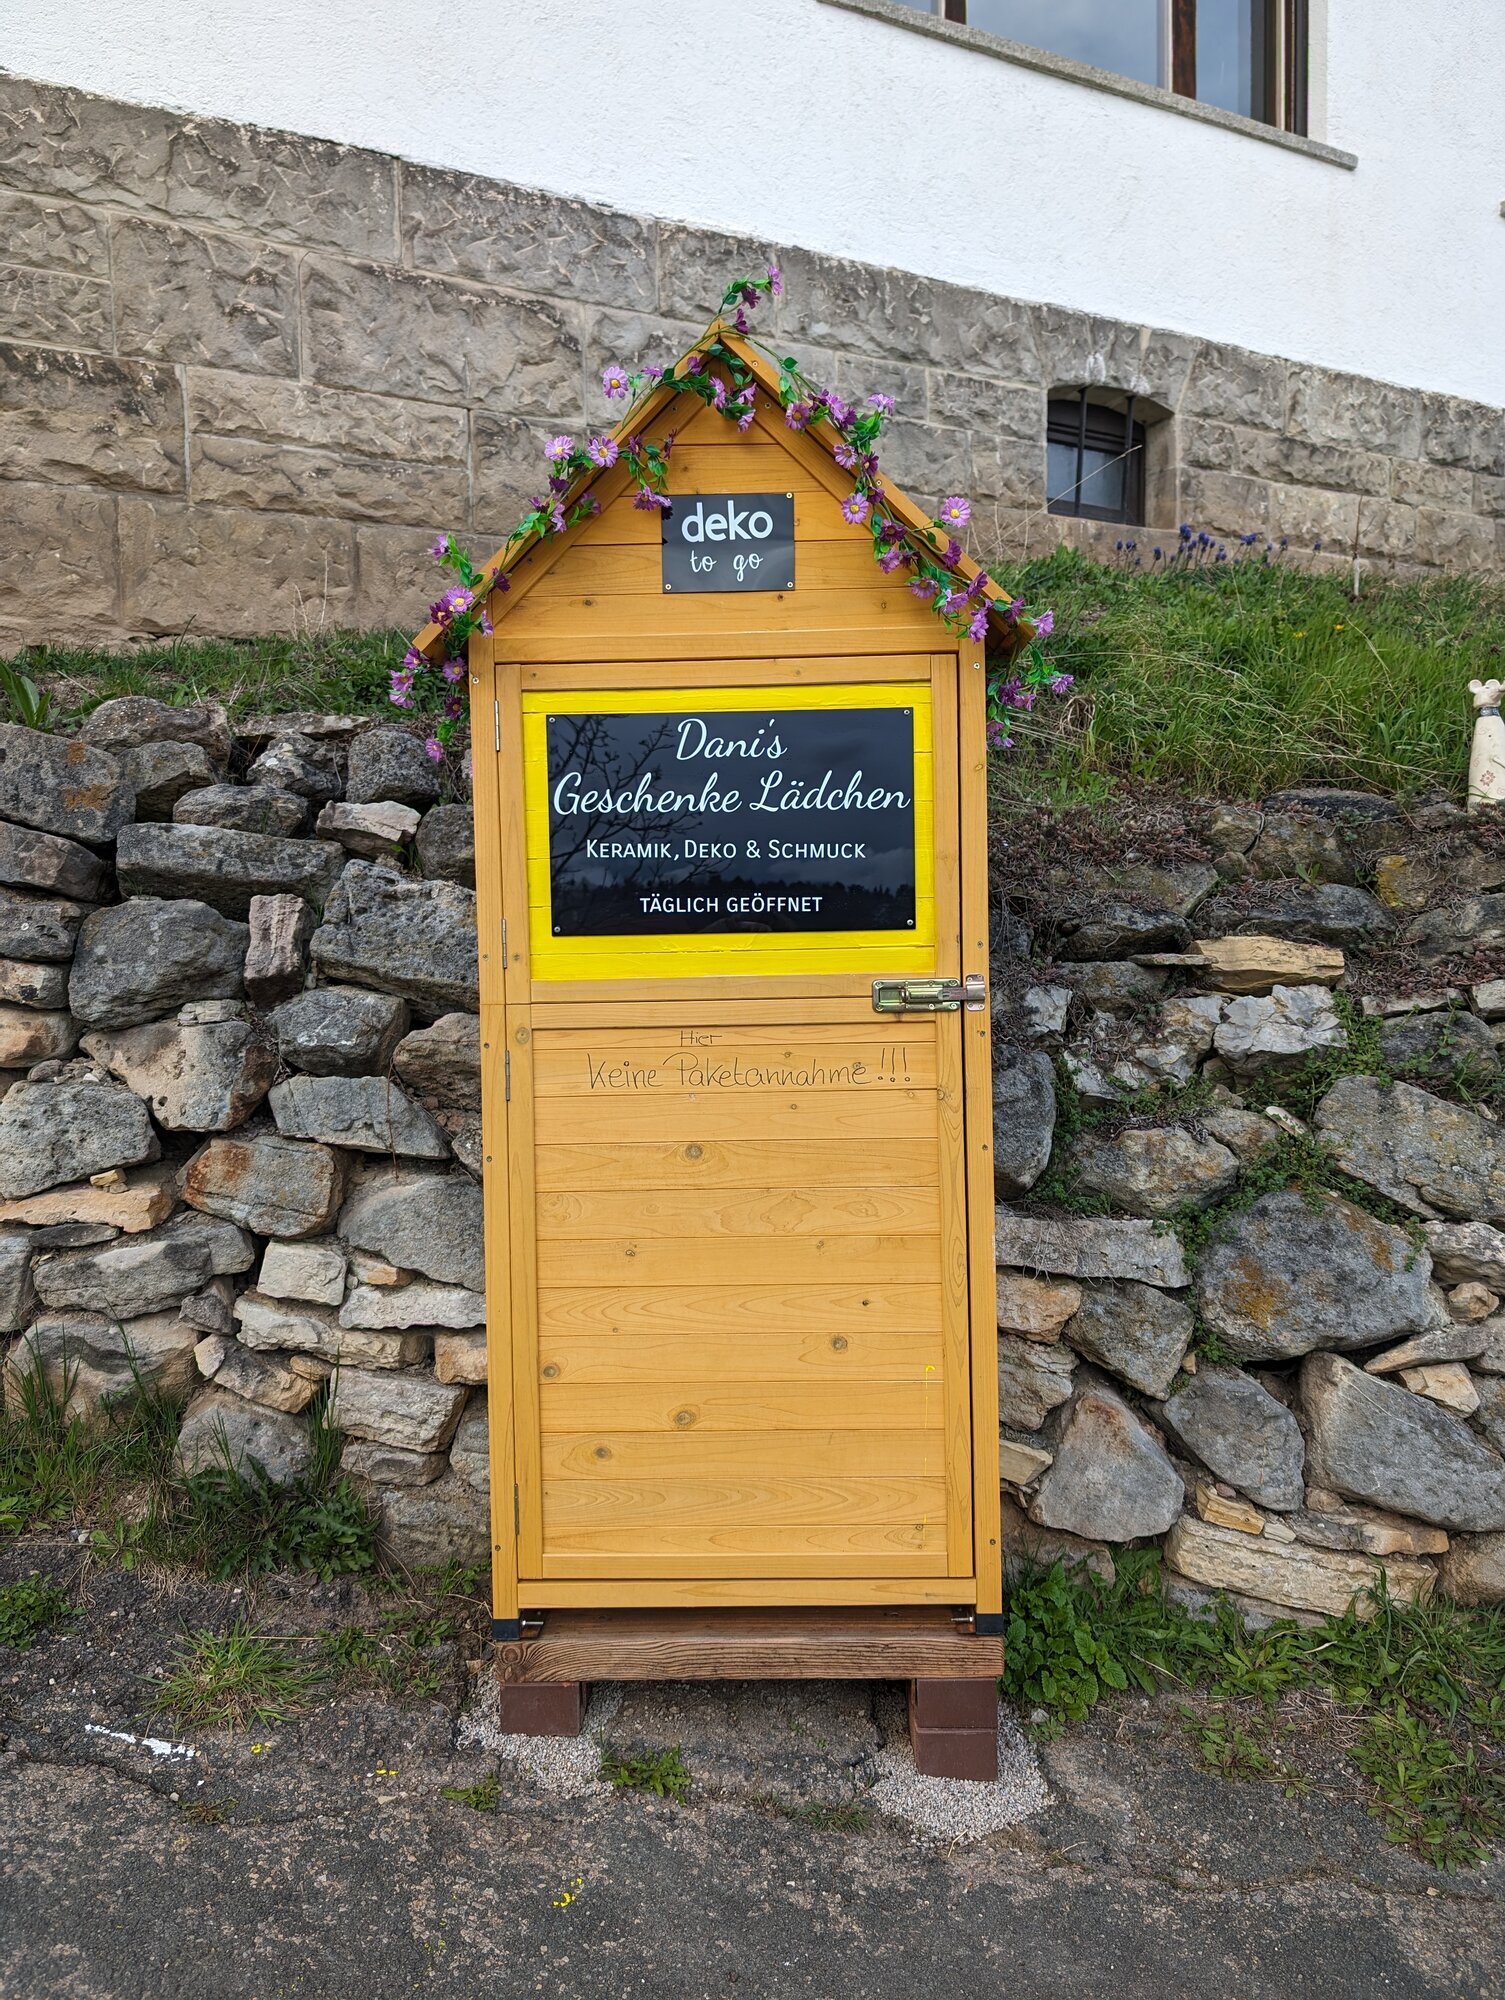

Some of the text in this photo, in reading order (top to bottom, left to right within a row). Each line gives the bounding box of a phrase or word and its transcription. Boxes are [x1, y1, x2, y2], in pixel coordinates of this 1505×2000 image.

[681, 500, 774, 543] deko
[690, 550, 764, 582] to go
[676, 718, 788, 761] Dani's
[553, 769, 911, 816] Geschenke Lädchen
[746, 839, 761, 859] &
[640, 892, 823, 913] TÄGLICH GEÖFFNET
[680, 1030, 722, 1047] Hier
[587, 1053, 663, 1090] Keine
[663, 1051, 873, 1088] Paketannahme
